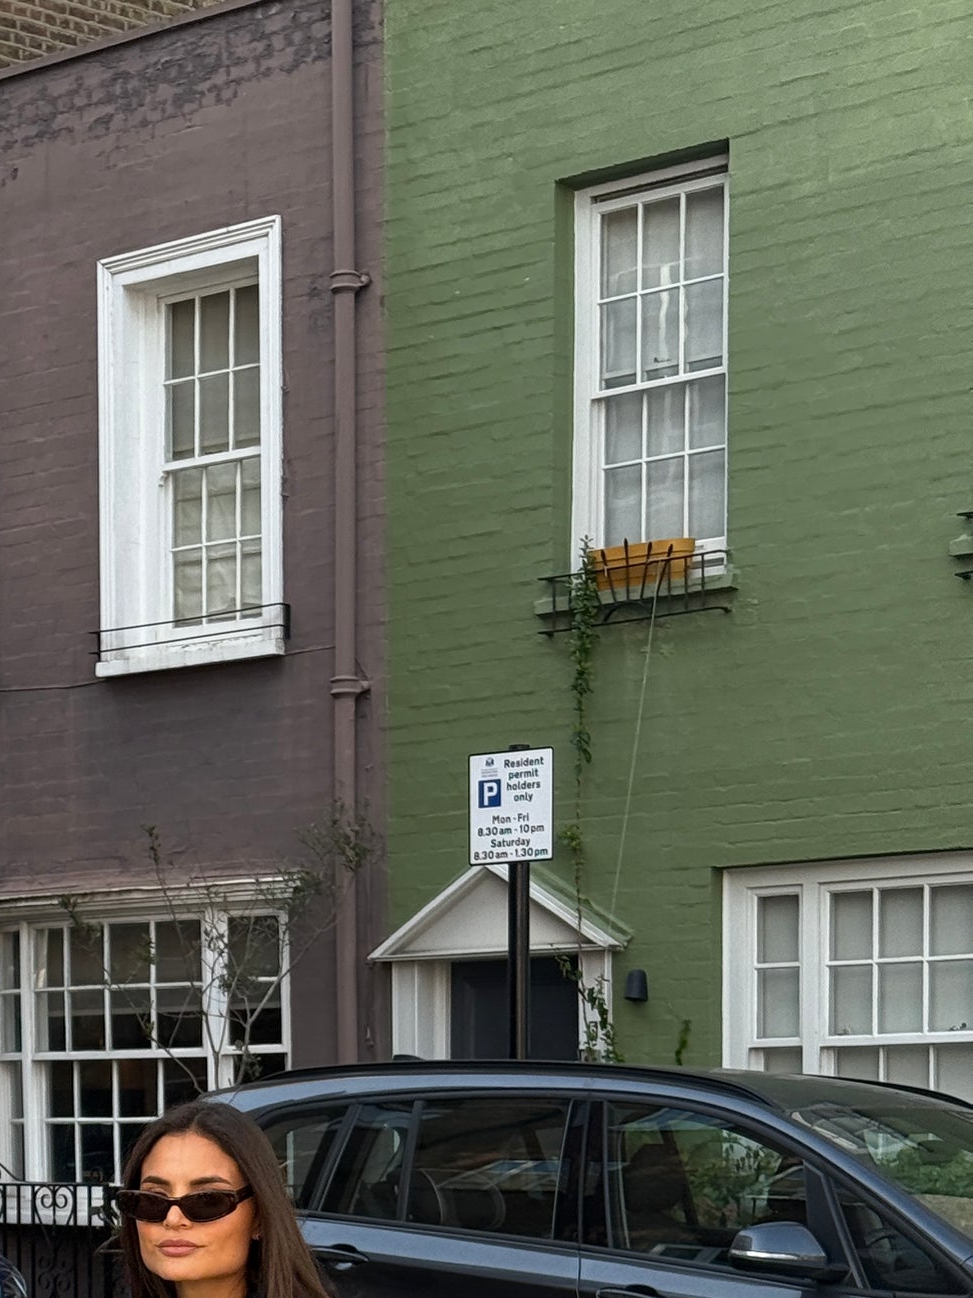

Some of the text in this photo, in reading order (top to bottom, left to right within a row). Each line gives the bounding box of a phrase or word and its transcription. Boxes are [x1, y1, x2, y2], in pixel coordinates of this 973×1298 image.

[504, 756, 544, 768] Resident
[508, 768, 539, 780] permit
[507, 781, 541, 791] holders
[483, 782, 498, 806] P
[513, 792, 534, 802] only
[490, 837, 531, 848] Saturday
